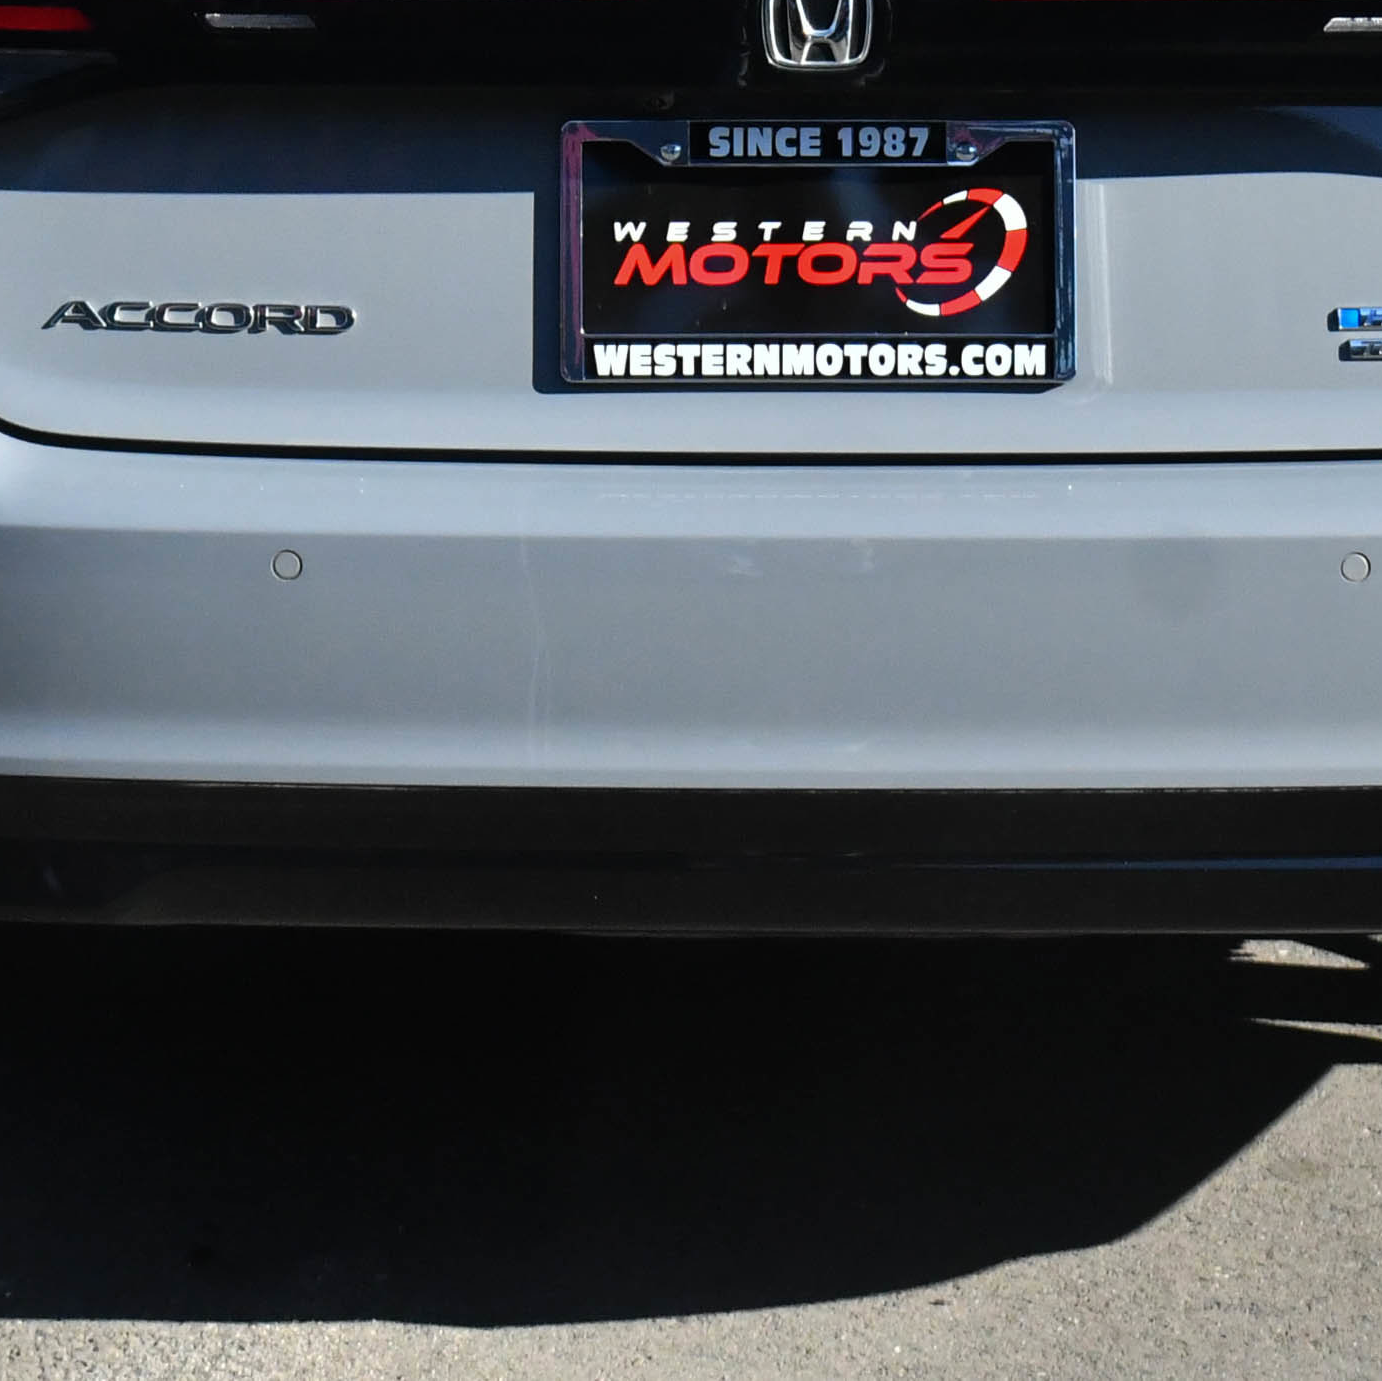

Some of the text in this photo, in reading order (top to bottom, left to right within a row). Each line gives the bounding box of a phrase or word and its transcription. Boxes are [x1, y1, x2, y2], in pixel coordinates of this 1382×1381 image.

[708, 126, 930, 158] SINCE 1987
[613, 220, 918, 242] WESTERN
[613, 242, 975, 286] MOTORS
[41, 300, 357, 335] ACCORD
[593, 342, 1047, 378] WESTERNMOTORS.COM
